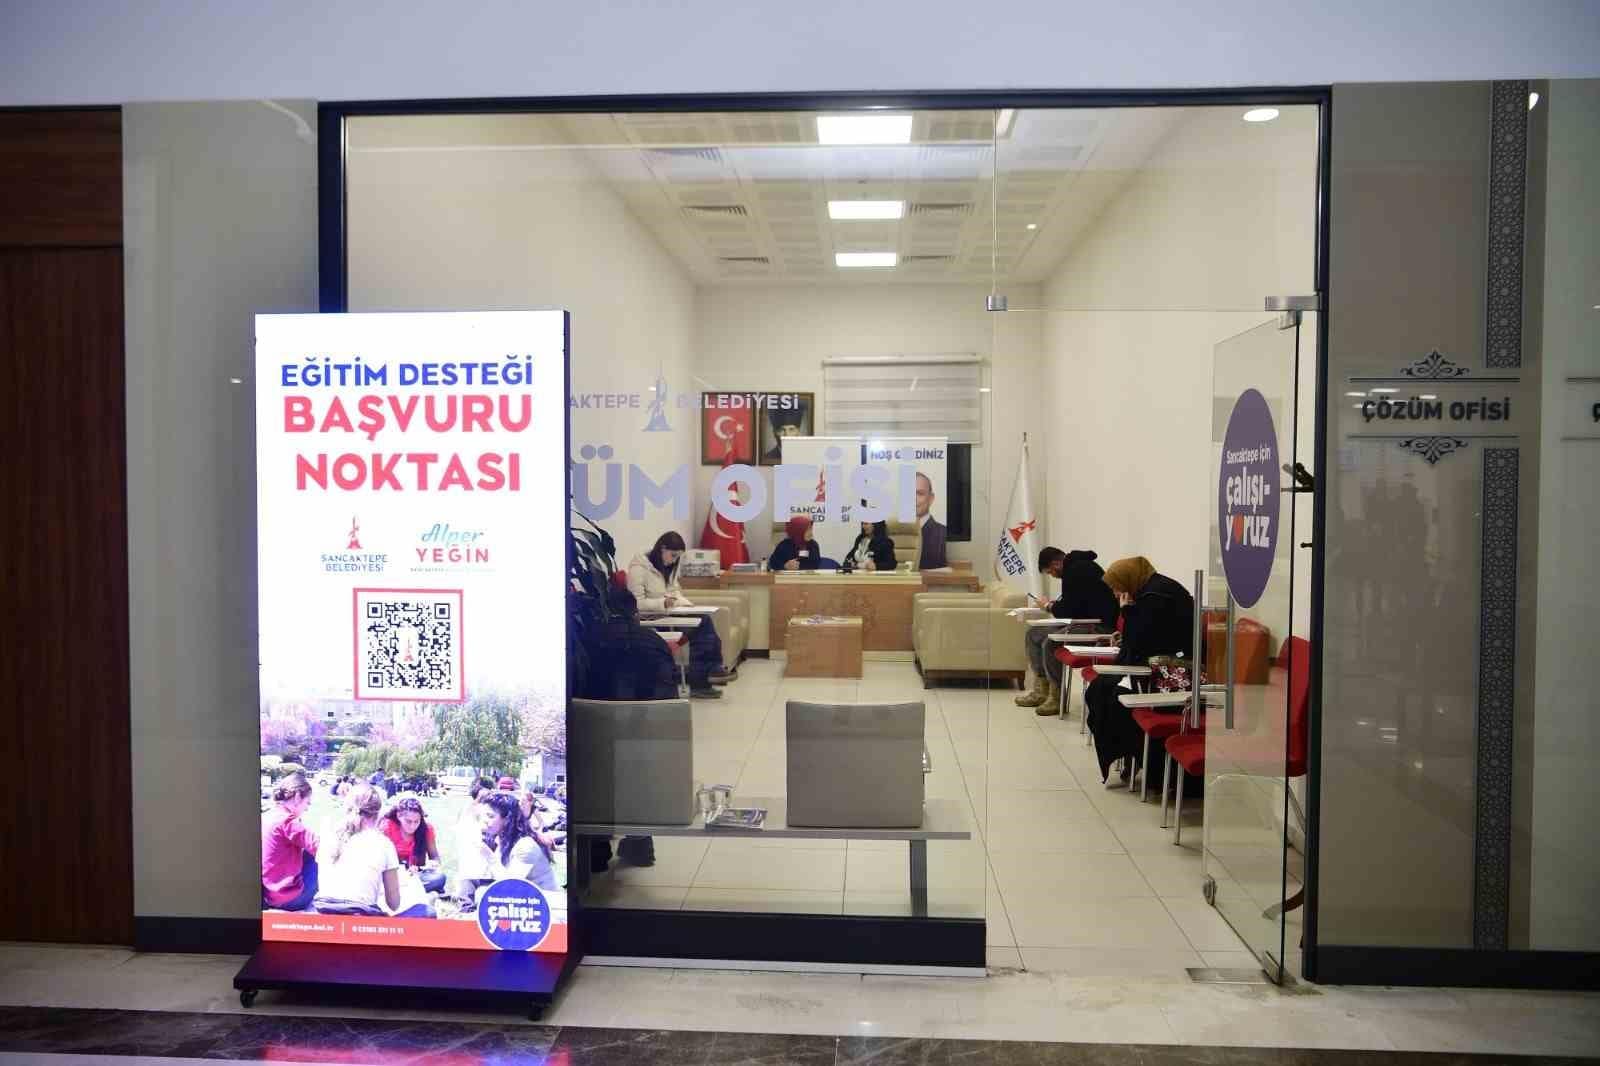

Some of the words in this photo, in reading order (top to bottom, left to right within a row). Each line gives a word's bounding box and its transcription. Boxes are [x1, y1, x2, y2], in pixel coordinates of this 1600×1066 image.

[281, 356, 388, 387] EĞİTİM
[399, 354, 533, 386] DESTEĞİ
[676, 393, 799, 410] BELEDİYESİ
[1361, 396, 1443, 423] ÇÖZÜM
[1449, 397, 1511, 421] OFİSİ
[283, 394, 532, 441] BAŞVURU
[1259, 443, 1271, 464] için
[296, 452, 521, 491] NOKTASI
[711, 446, 917, 523] OFİSİ
[321, 554, 388, 563] SANCAKTEPE
[416, 544, 489, 563] YEĞİN
[326, 563, 384, 573] BELEDİYESİ
